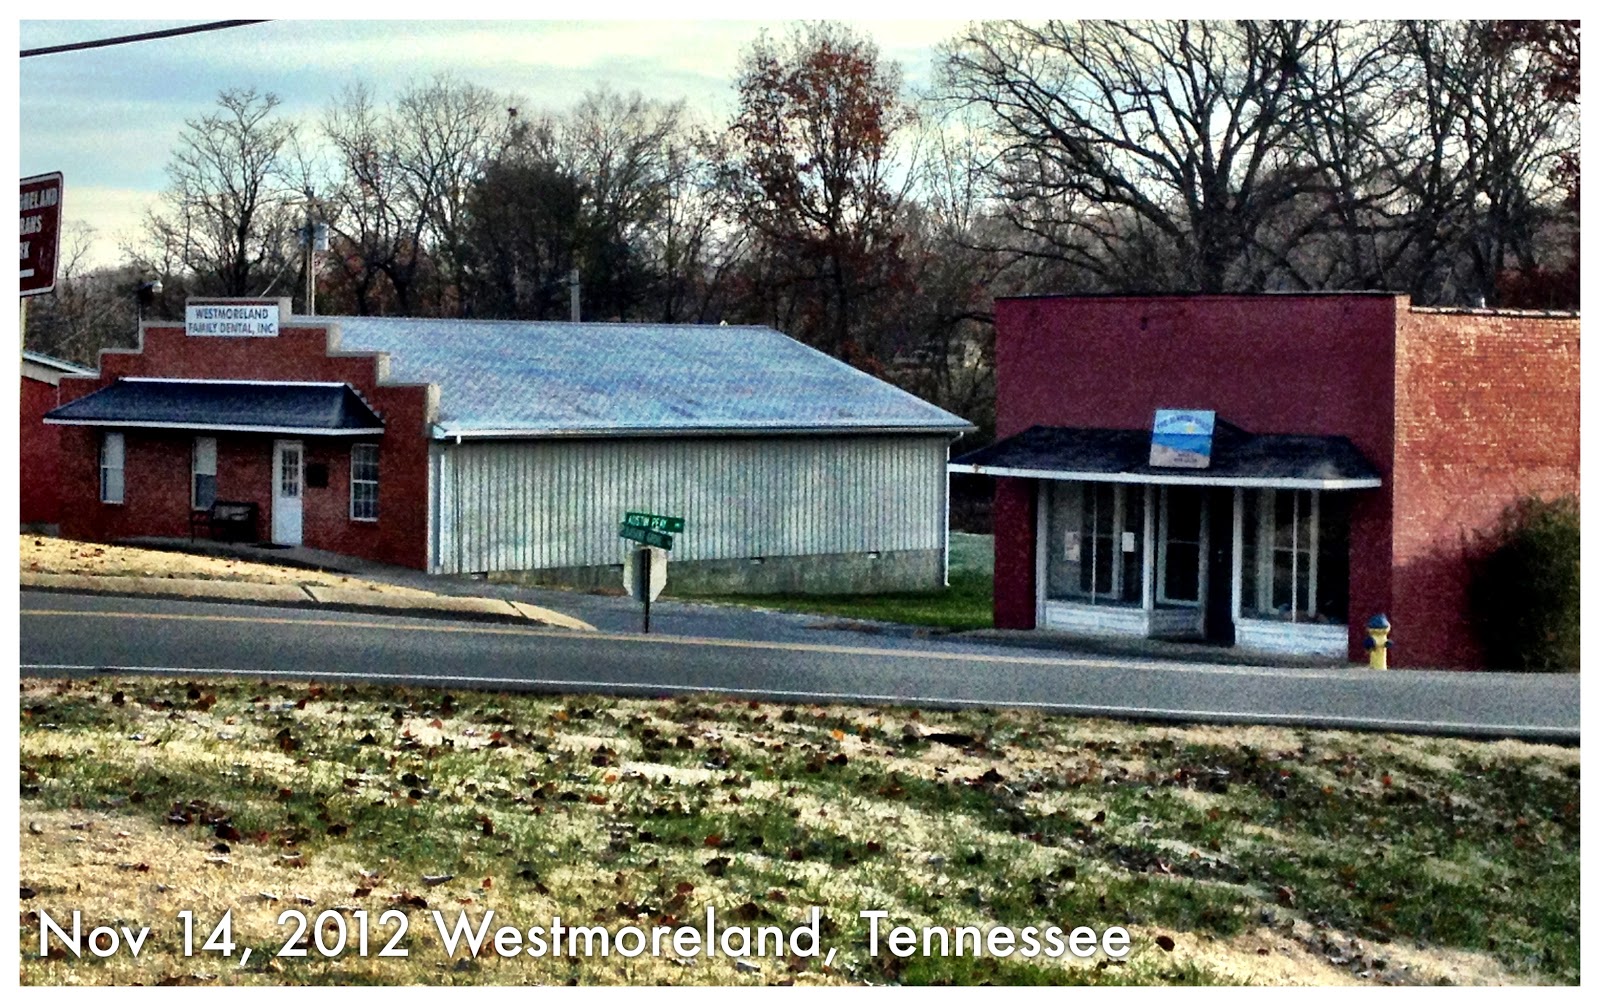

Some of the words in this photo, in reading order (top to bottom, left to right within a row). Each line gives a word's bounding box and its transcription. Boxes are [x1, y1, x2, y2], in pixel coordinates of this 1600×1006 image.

[195, 308, 268, 319] WESTMORELAND
[188, 322, 218, 334] FAMILY
[220, 322, 255, 335] DENTAL,
[257, 322, 277, 334] INC.
